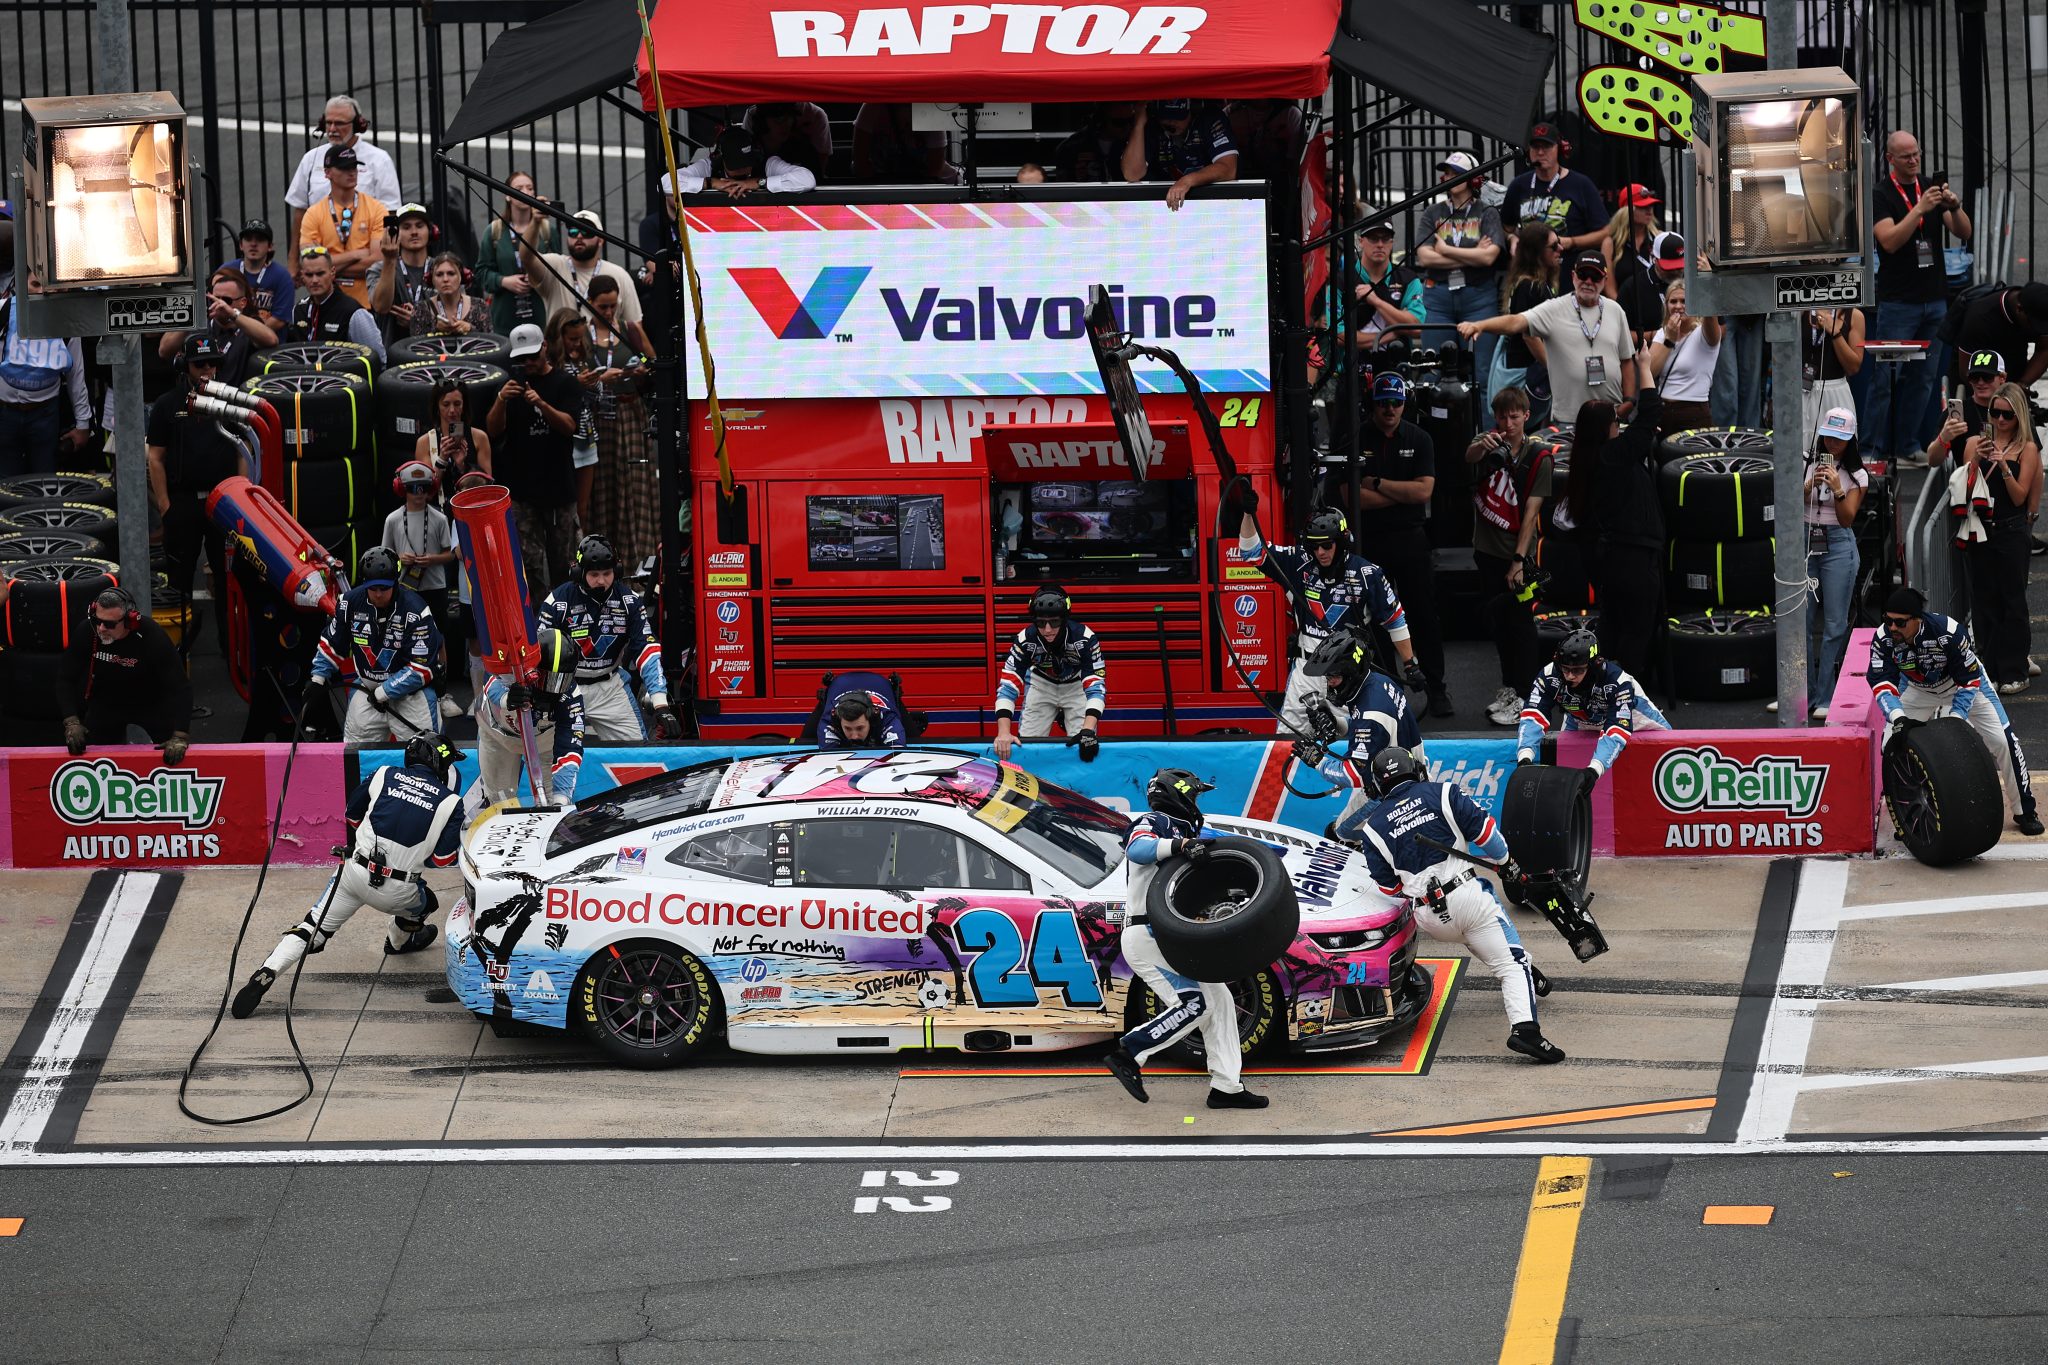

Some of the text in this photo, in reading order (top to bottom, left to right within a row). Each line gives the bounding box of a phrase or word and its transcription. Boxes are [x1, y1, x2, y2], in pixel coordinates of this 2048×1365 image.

[770, 4, 1207, 58] RAPTOR
[1841, 273, 1855, 283] 24
[172, 297, 186, 306] 23
[879, 284, 1216, 342] Valvoine
[9, 332, 68, 369] 696
[1974, 353, 1993, 366] 24
[1219, 398, 1262, 427] 24
[708, 551, 745, 564] ALL-PRO
[719, 602, 737, 622] hp
[1238, 596, 1255, 616] hp
[1305, 624, 1330, 637] Valvo
[1352, 645, 1364, 664] 24
[437, 744, 451, 758] 24
[393, 772, 441, 796] OSSOWSKI
[1174, 780, 1191, 794] 24
[1652, 746, 1829, 818] O'Reilly
[50, 759, 225, 830] O'Reilly
[817, 806, 920, 817] WILLIAM BYRON
[1386, 797, 1423, 822] HOLMAN
[63, 833, 220, 859] AUTO PARTS
[1665, 821, 1823, 848] AUTO PARTS
[545, 887, 924, 934] Blood Cancer United
[1547, 898, 1559, 911] 24
[713, 934, 845, 960] Not for nothing
[486, 960, 511, 981] LU
[743, 961, 765, 982] hp
[953, 907, 1108, 1012] 24
[855, 969, 930, 1000] STRENGTH
[1346, 961, 1367, 985] 24
[481, 982, 518, 991] LIBERTY
[523, 991, 560, 1000] AXALTA
[583, 975, 598, 1023] EAGLE
[681, 954, 710, 1045] GOODYEAR
[1240, 972, 1273, 1054] OODYEAR
